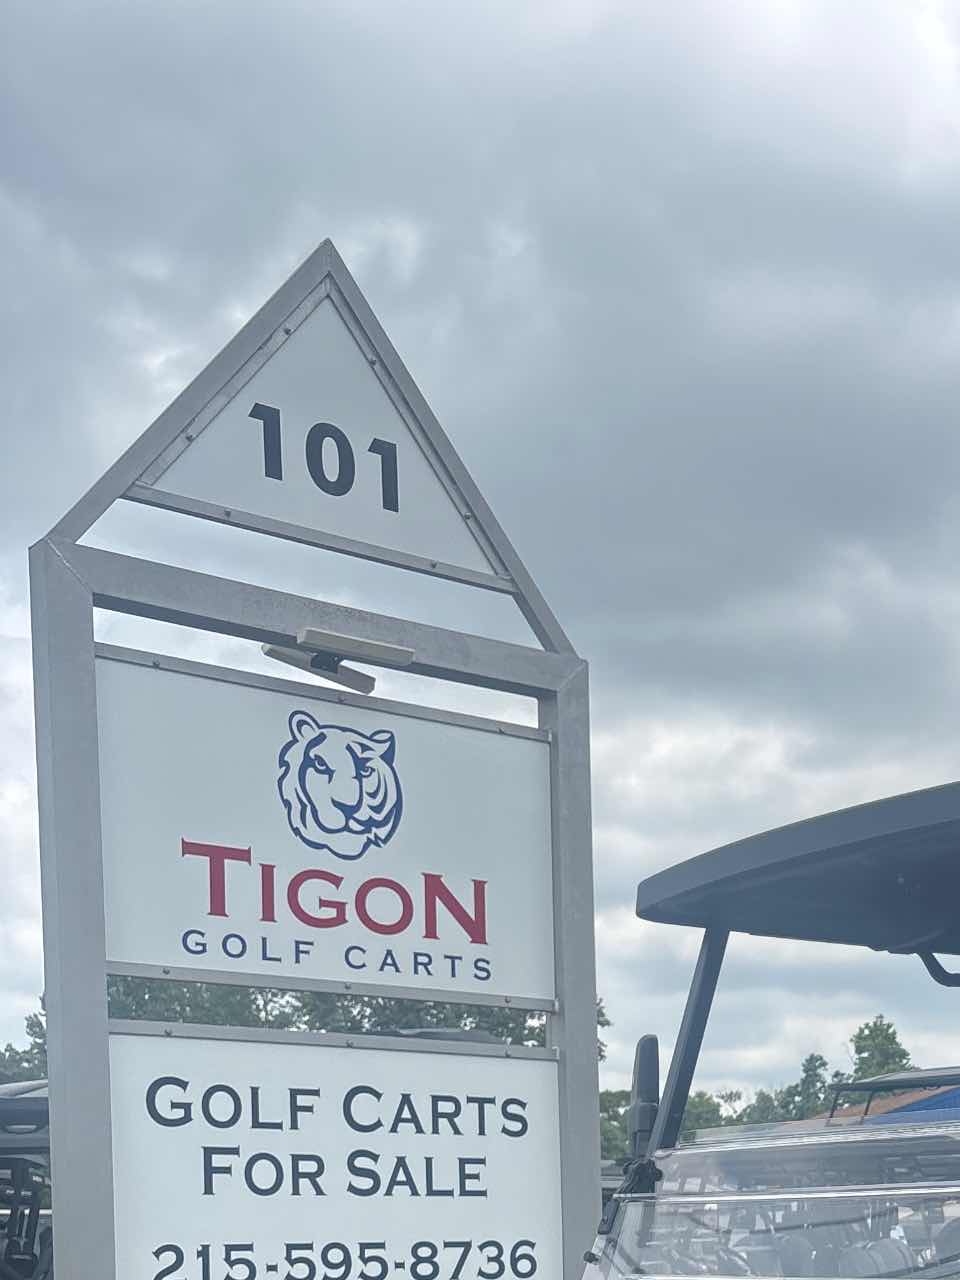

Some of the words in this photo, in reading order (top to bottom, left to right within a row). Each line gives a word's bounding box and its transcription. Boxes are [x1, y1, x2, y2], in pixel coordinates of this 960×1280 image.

[248, 402, 400, 513] 101
[181, 837, 489, 945] TIGON
[182, 929, 315, 964] GOLF
[344, 945, 492, 981] CARTS
[145, 1076, 321, 1131] GOLF
[342, 1085, 529, 1138] CARTS
[201, 1146, 327, 1196] FOR
[346, 1149, 488, 1198] SALE
